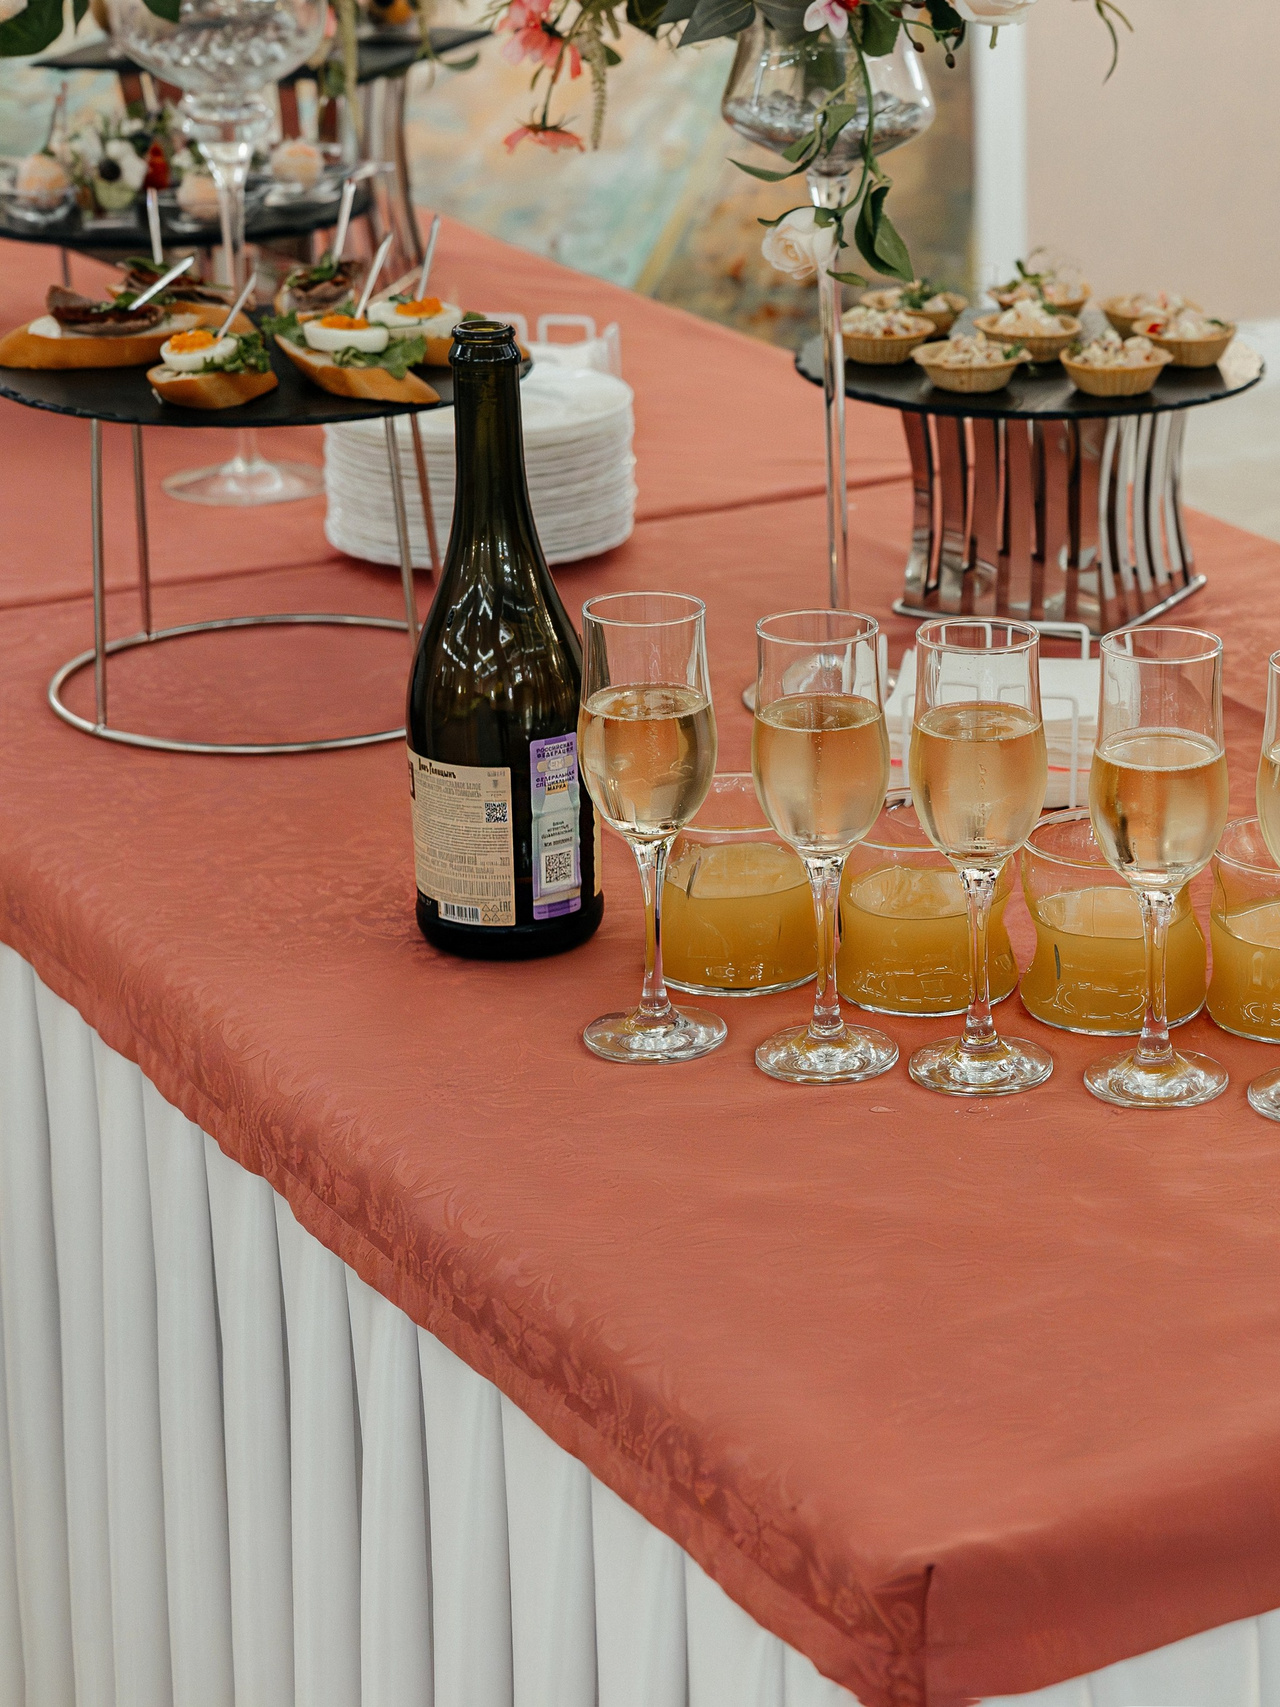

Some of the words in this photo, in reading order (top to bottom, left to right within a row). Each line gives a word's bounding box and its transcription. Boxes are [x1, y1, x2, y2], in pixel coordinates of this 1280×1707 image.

[536, 741, 573, 754] РОССИЙСКАЯ
[536, 746, 574, 759] ФЕДЕРАЦИЯ
[547, 783, 566, 792] МАРКА
